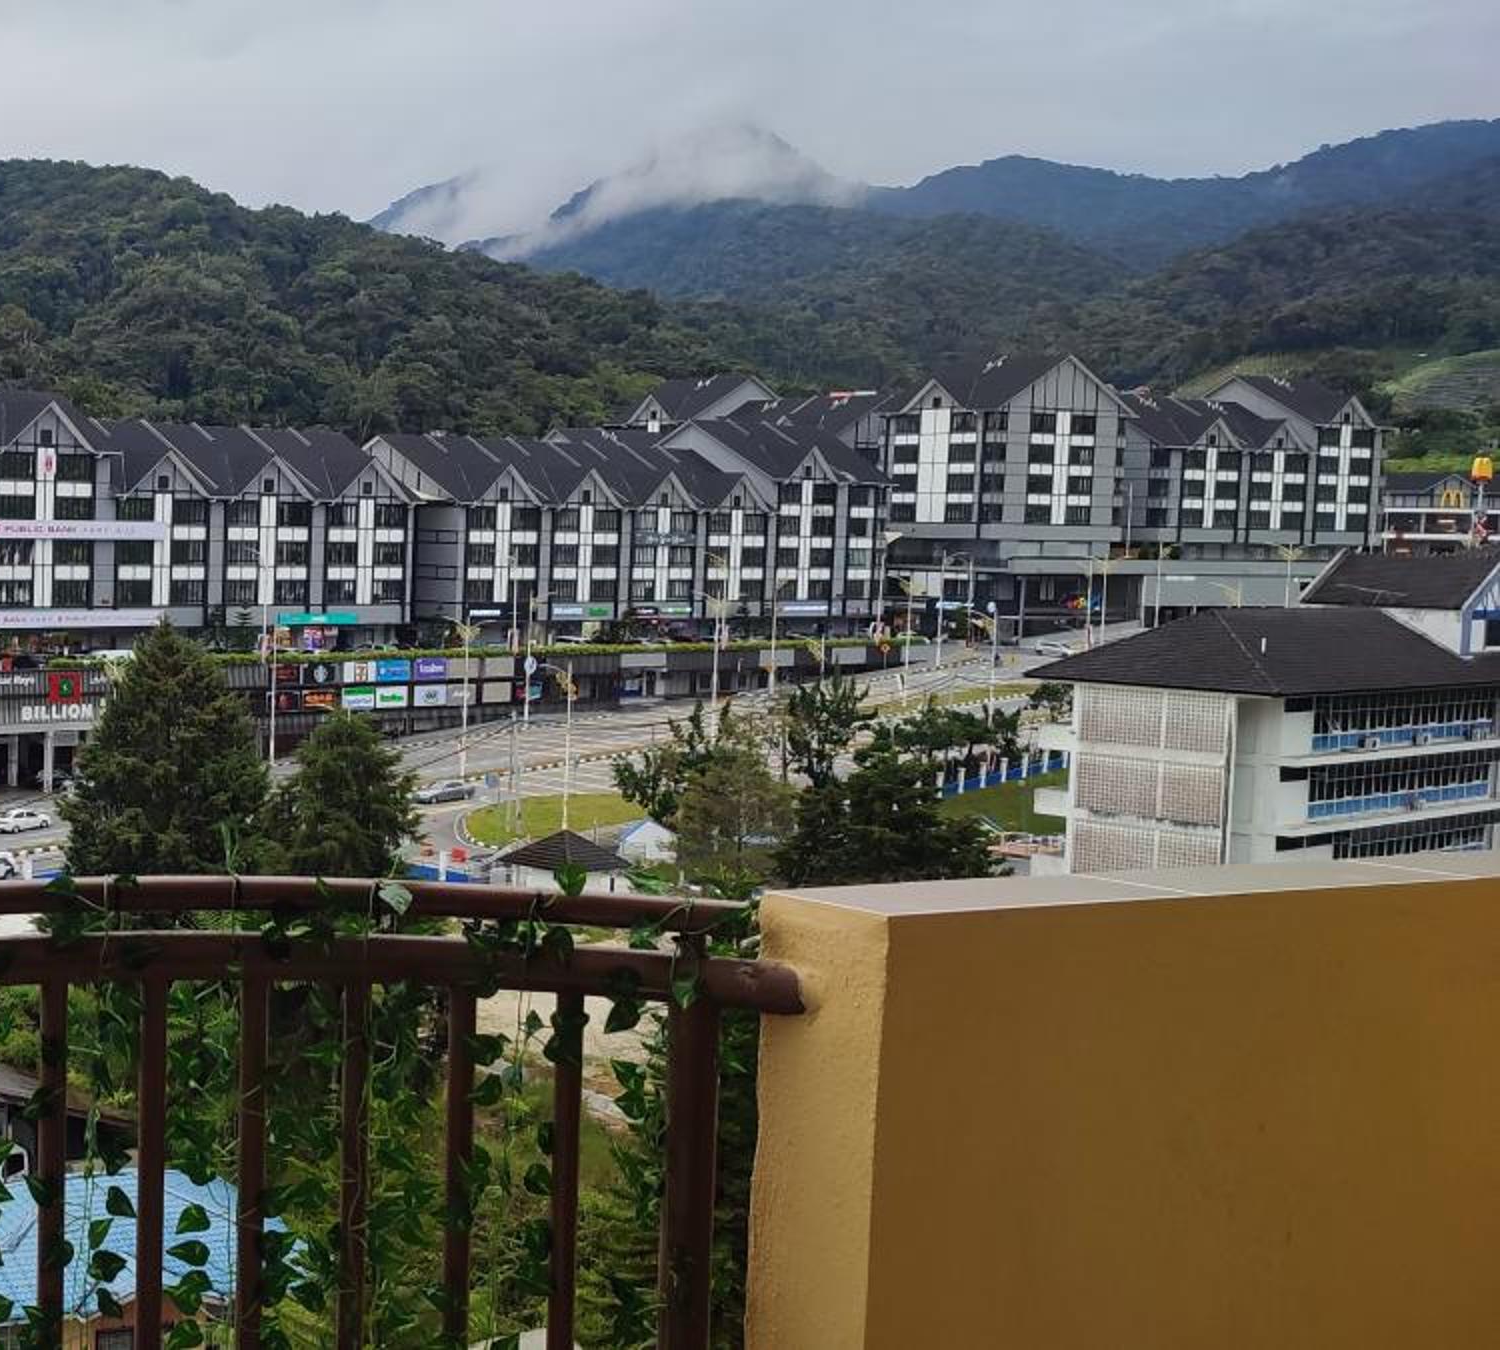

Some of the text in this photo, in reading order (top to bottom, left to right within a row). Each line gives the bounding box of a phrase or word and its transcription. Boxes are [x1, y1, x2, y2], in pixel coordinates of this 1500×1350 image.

[4, 524, 44, 534] PUBLIC
[47, 525, 78, 534] BANK
[21, 703, 93, 721] BILLION
